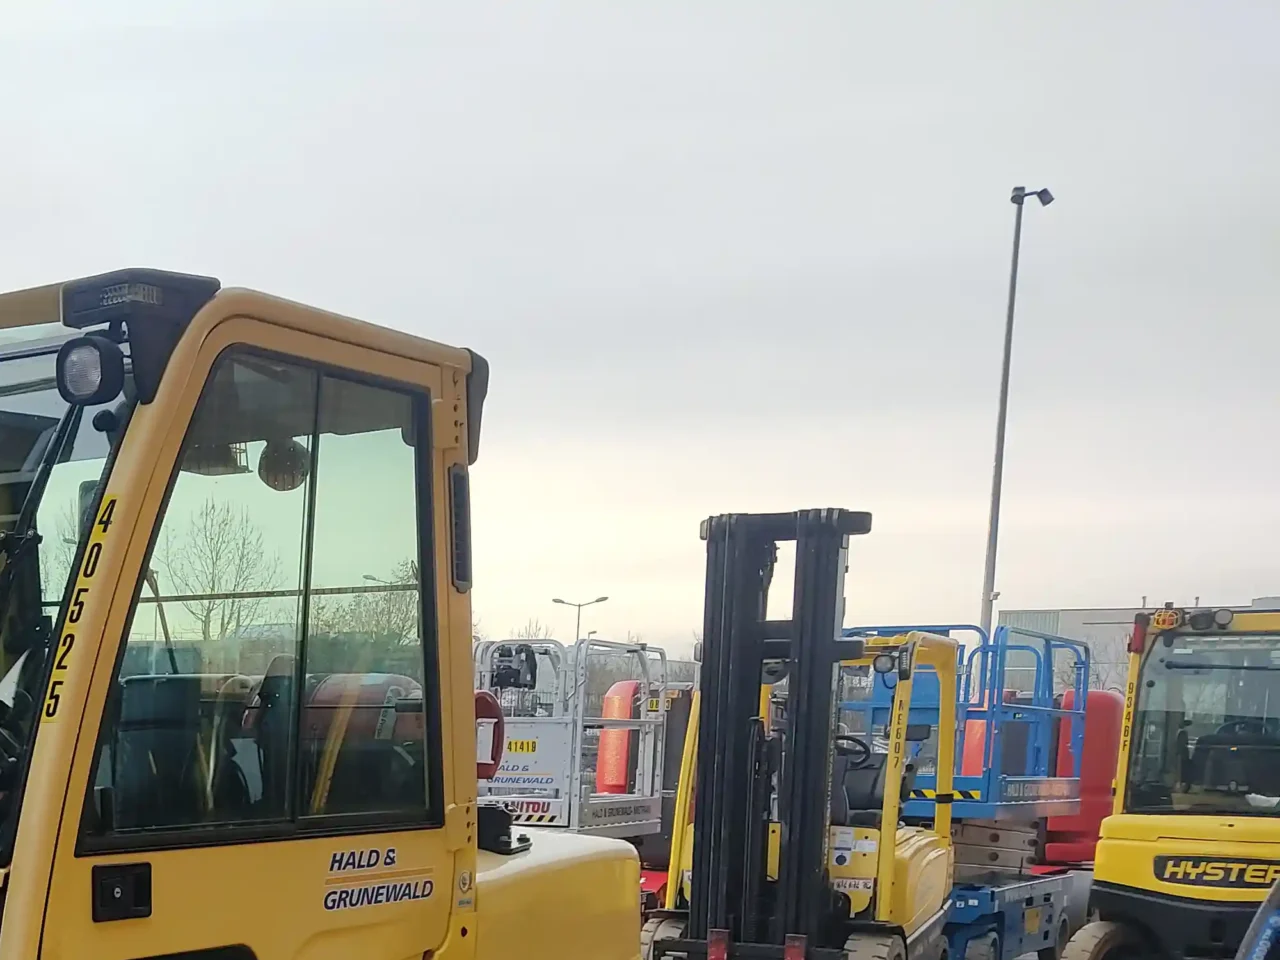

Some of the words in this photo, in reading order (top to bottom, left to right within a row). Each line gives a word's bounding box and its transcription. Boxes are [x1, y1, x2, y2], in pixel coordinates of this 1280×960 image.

[45, 498, 117, 718] 40525
[327, 850, 380, 871] HALD
[383, 848, 396, 866] &
[323, 880, 434, 910] GRUNEWALD
